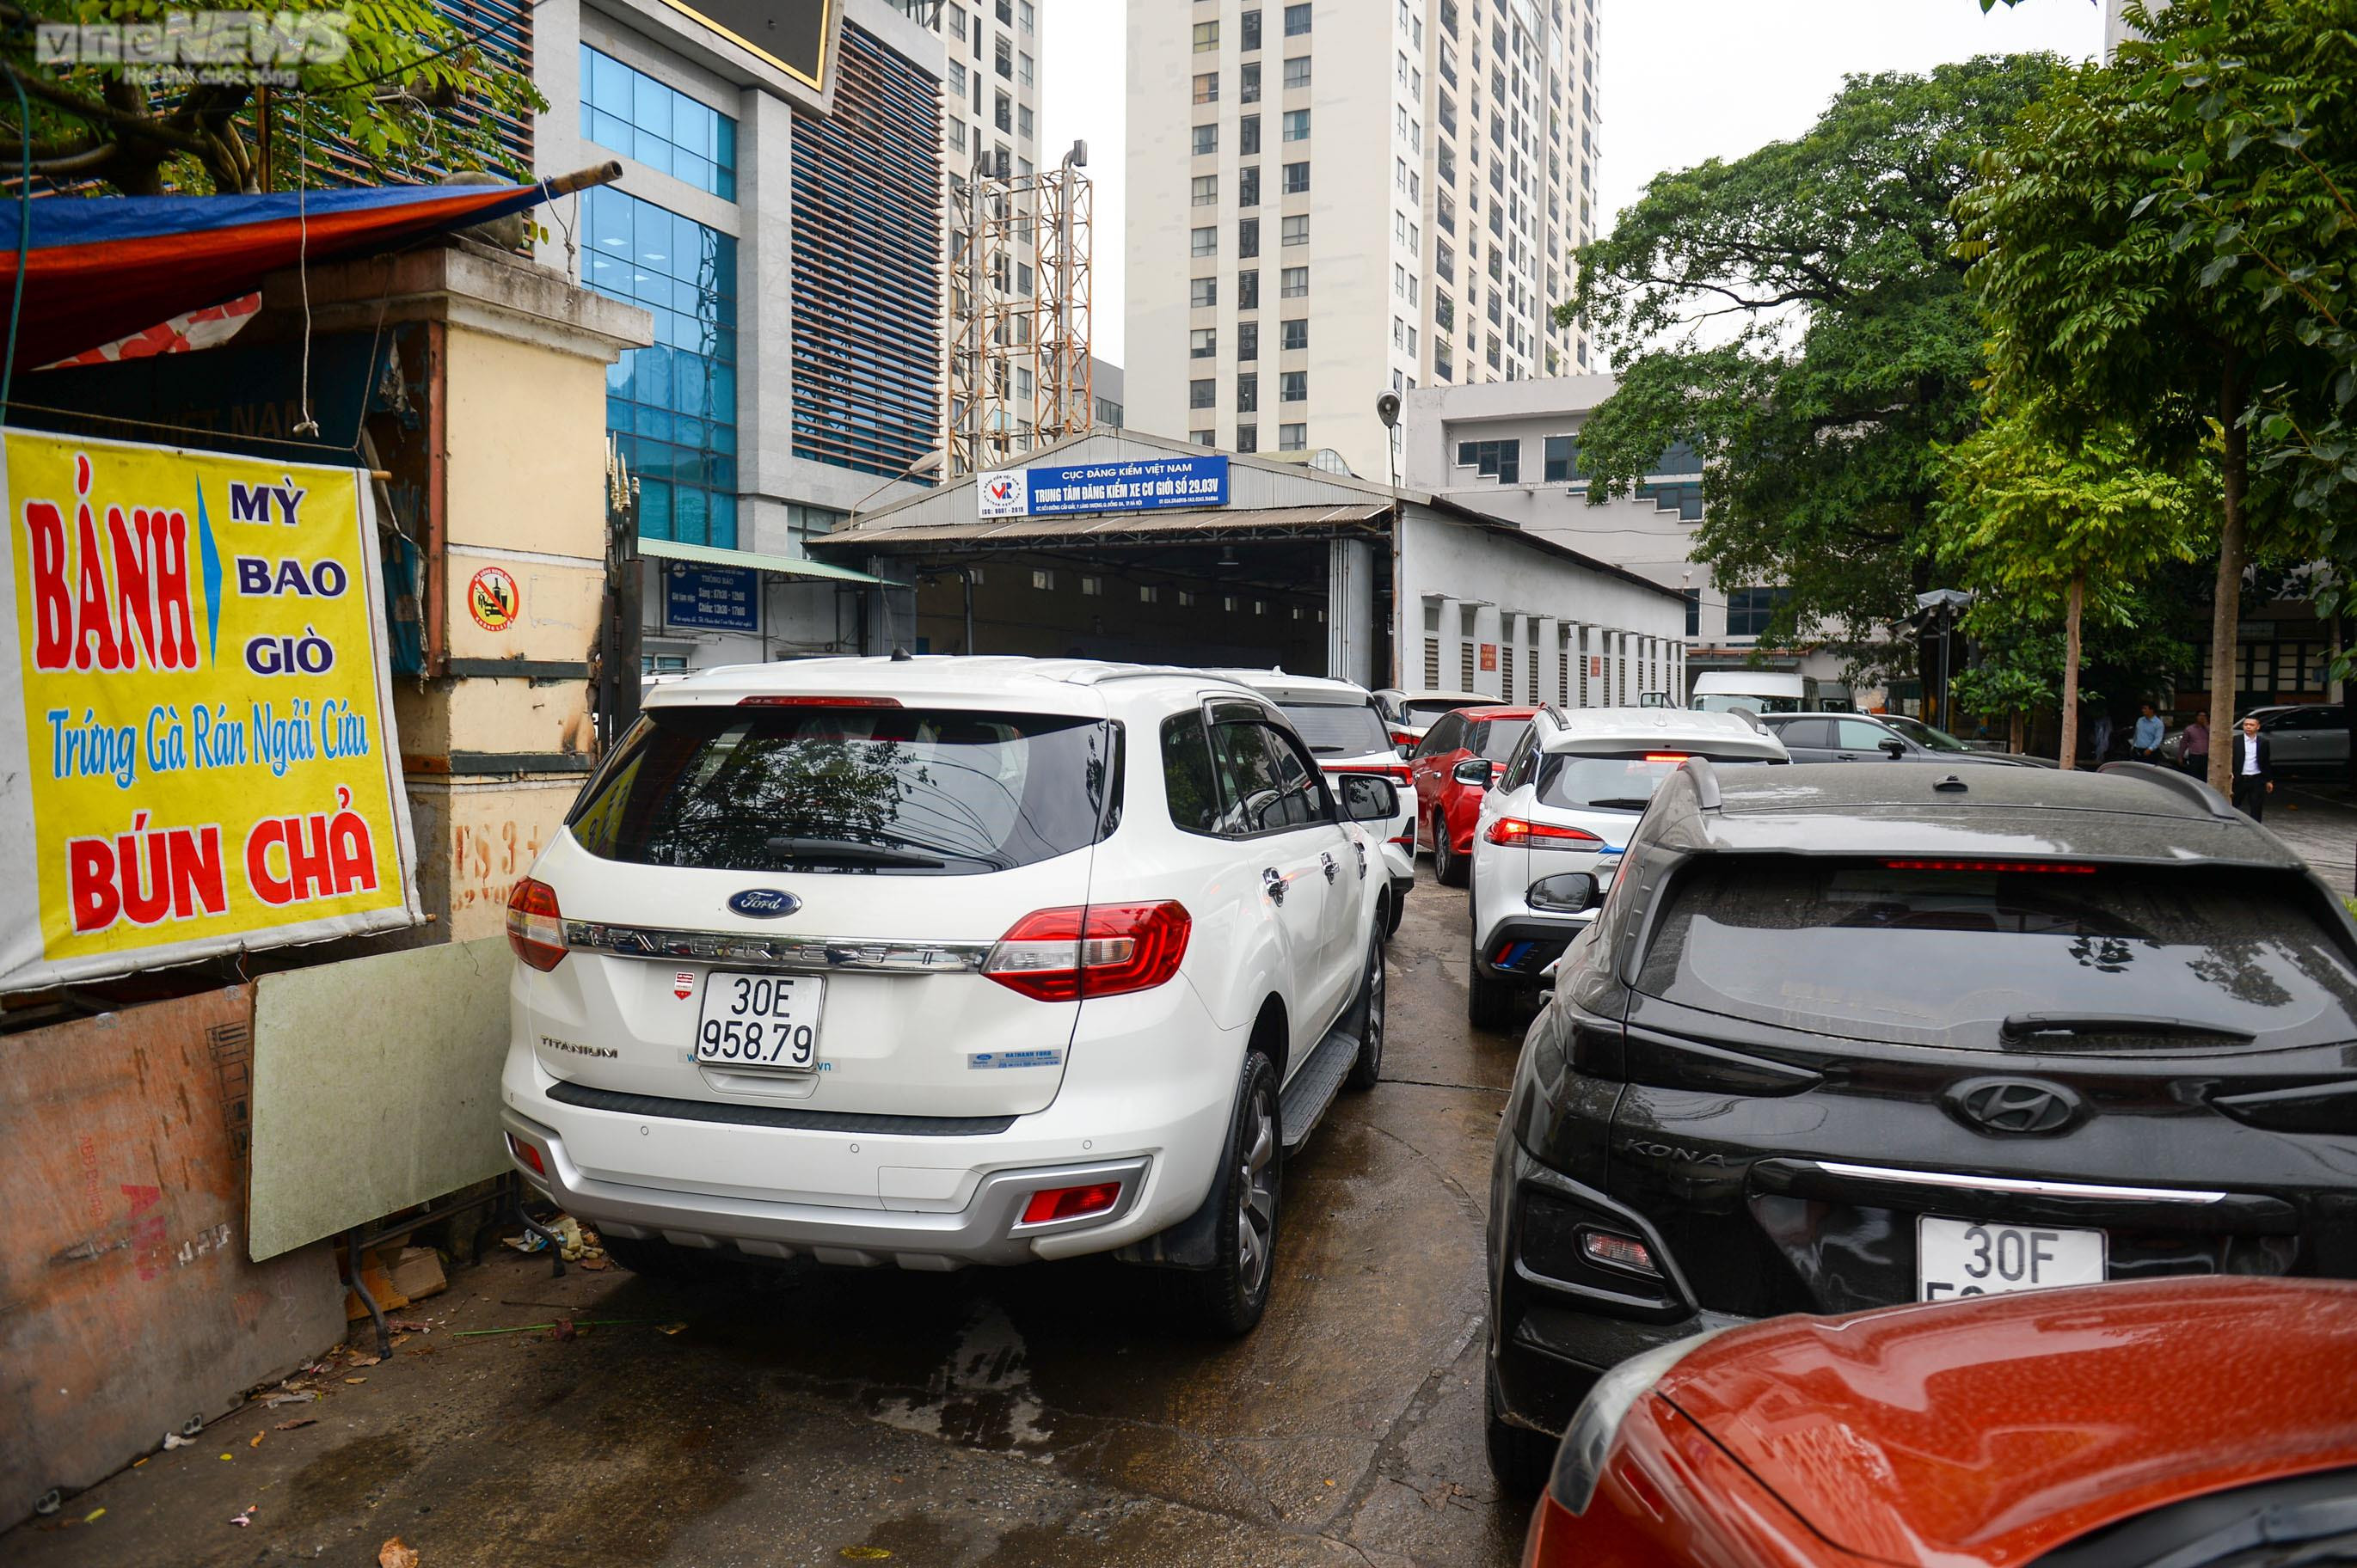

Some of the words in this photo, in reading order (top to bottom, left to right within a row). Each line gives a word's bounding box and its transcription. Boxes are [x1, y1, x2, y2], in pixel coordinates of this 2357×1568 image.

[1034, 487, 1061, 503] TRUNG
[1063, 484, 1080, 501] TÂM
[1082, 483, 1105, 500] ĐĂNG
[1106, 478, 1127, 499] KIỂM
[1129, 483, 1141, 497] XE
[1142, 481, 1154, 496] CƠ
[1156, 477, 1174, 496] GIỚI
[1175, 475, 1188, 494] SỐ
[1188, 478, 1218, 494] 29.03V
[1062, 470, 1083, 481] CỤC
[1087, 468, 1116, 478] ĐĂNG
[1119, 462, 1142, 475] KIỂM
[1145, 463, 1164, 475] VIỆT
[1167, 463, 1192, 473] NAM
[230, 477, 304, 524] MỲ
[236, 558, 347, 597] BAO
[246, 627, 333, 674] GIÒ
[48, 708, 138, 788] Trứng
[146, 705, 186, 772] Gà
[193, 703, 246, 769] Rán
[253, 698, 315, 776] Ngải
[319, 699, 369, 758] Cứu
[70, 812, 225, 932] BÚN
[247, 787, 377, 904] CHẢ
[740, 891, 783, 910] Ford
[589, 929, 946, 965] EVEREST
[731, 977, 795, 1019] 30E
[540, 1035, 618, 1058] TITANIUM
[702, 1020, 813, 1063] 958.79
[1624, 1138, 1725, 1168] KONA
[1964, 1227, 2059, 1283] 30F
